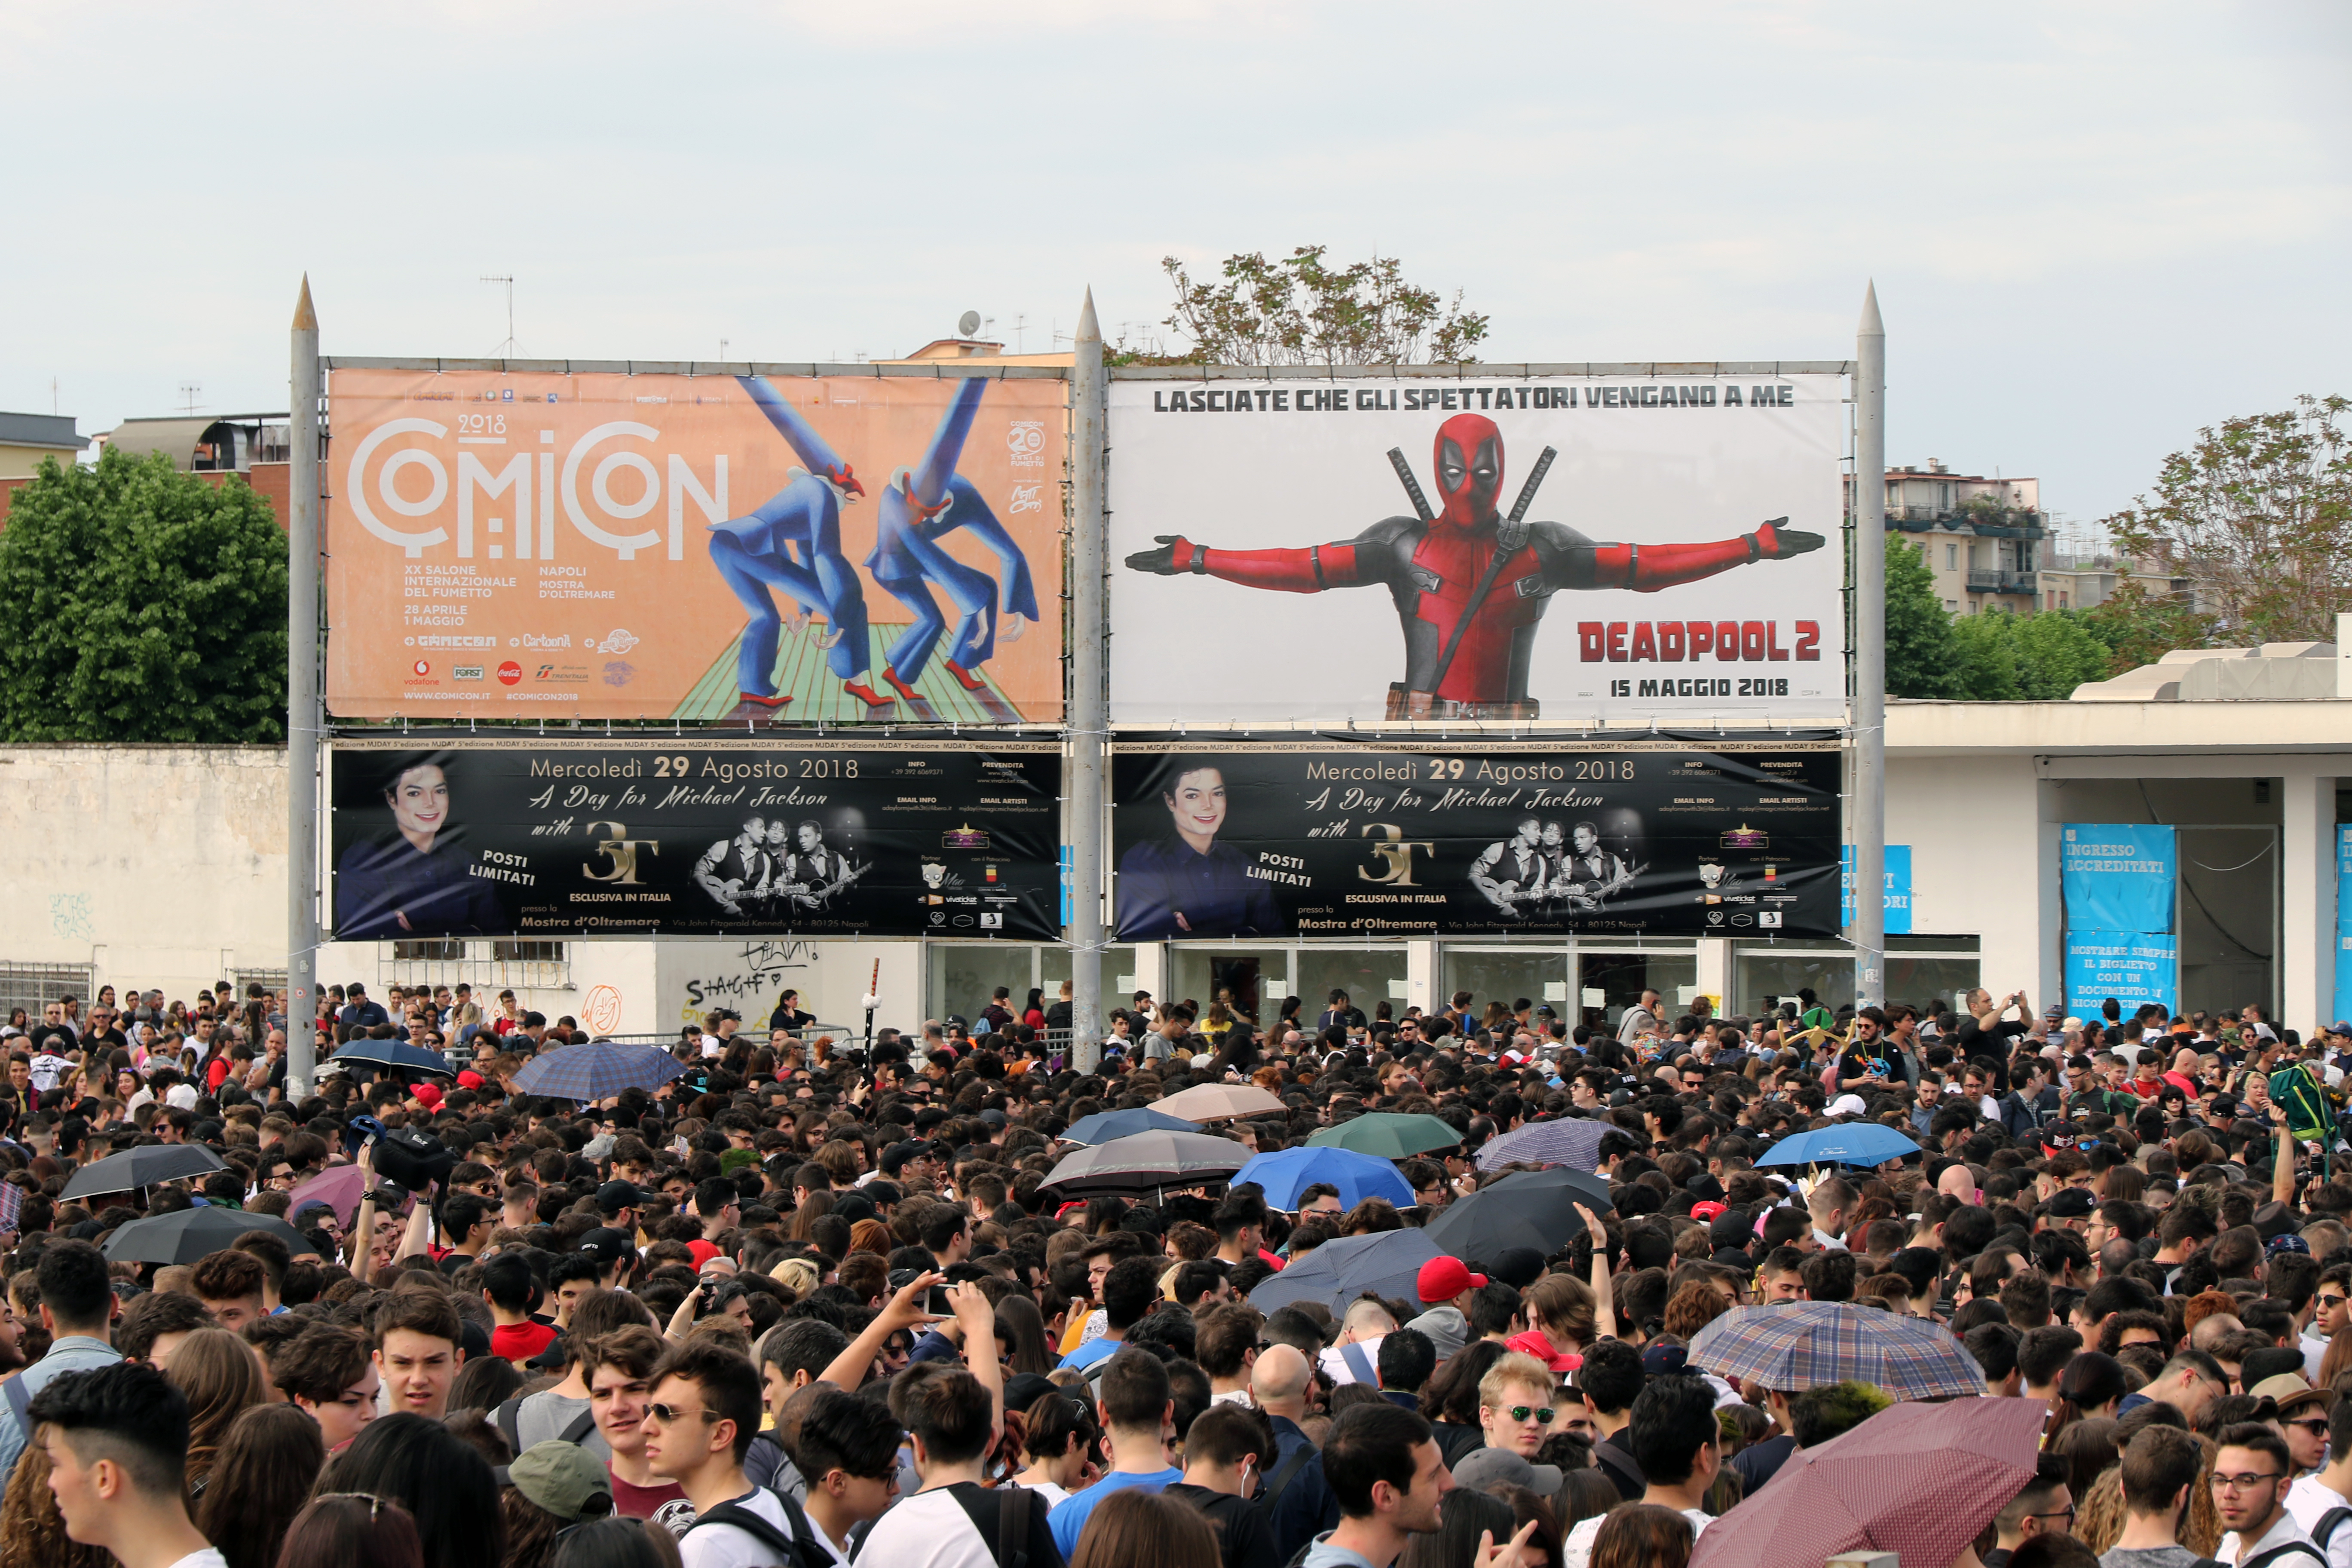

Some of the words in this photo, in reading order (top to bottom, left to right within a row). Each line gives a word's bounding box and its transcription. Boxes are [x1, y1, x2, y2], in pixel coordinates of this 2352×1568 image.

[1154, 390, 1289, 412] LASCIATE
[1295, 389, 1349, 411] CHE
[1356, 389, 1397, 411] GLI
[1404, 386, 1577, 411] SPETTATORI
[1584, 385, 1716, 408] VENGANO
[1724, 386, 1744, 407] A
[1751, 385, 1794, 407] ME
[458, 414, 506, 434] 2018
[405, 566, 422, 575] XX
[426, 566, 476, 576] SALONE
[539, 567, 586, 576] NAPOLI
[405, 577, 517, 587] INTERNAZIONALE
[539, 580, 585, 589] MOSTRA
[405, 588, 429, 597] DEL
[432, 588, 492, 598] FUMETTO
[404, 605, 419, 615] 28
[423, 605, 468, 615] APRILE
[404, 616, 409, 625] 1
[413, 616, 464, 626] MAGGIO
[1577, 620, 1790, 663] DEADPOOL
[1795, 620, 1821, 661] 2
[455, 669, 482, 677] FORST
[1611, 679, 1631, 697] 15
[1638, 678, 1731, 697] MAGGIO
[1738, 678, 1788, 696] 2018
[404, 692, 491, 701] WWW.COMICON.IT
[506, 693, 579, 701] #COMICON2018
[530, 758, 642, 778] Mercoledì
[653, 756, 690, 778] 29
[701, 756, 788, 783] Agosto
[799, 759, 859, 778] 2018
[1306, 760, 1418, 780] Mercoledì
[1428, 759, 1465, 780] 29
[1476, 758, 1564, 785] Agosto
[1575, 760, 1635, 781] 2018
[529, 784, 553, 808] A
[564, 784, 611, 811] Day
[614, 785, 647, 811] for
[655, 784, 746, 810] Michael
[750, 785, 828, 808] Jackson
[1305, 787, 1329, 811] A
[1339, 787, 1387, 813] Day
[1390, 787, 1422, 813] for
[1429, 787, 1520, 812] Michael
[1525, 787, 1604, 810] Jackson
[531, 817, 572, 838] with
[1308, 819, 1349, 839] with
[2066, 844, 2135, 857] INGRESSO
[483, 849, 528, 868] POSTI
[1259, 851, 1304, 870] POSTI
[2067, 860, 2164, 873] ACCREDITATI
[469, 864, 536, 887] LIMITATI
[1246, 865, 1312, 888] LIMITATI
[570, 893, 623, 903] ESCLUSIVA
[625, 893, 637, 902] IN
[640, 893, 671, 902] ITALIA
[1345, 894, 1399, 903] ESCLUSIVA
[1400, 894, 1413, 903] IN
[1415, 894, 1447, 903] ITALIA
[521, 906, 548, 914] presso
[549, 904, 557, 913] la
[1298, 907, 1324, 916] presso
[1326, 906, 1334, 914] la
[521, 916, 570, 927] Mostra
[689, 919, 708, 928] John
[710, 919, 750, 929] Fitzgerald
[842, 920, 870, 929] Napoli
[1298, 919, 1347, 929] Mostra
[1465, 921, 1484, 929] John
[1619, 920, 1647, 930] Napoli
[2070, 946, 2128, 956] MOSTRARE
[2132, 947, 2176, 959] SEMPRE
[2084, 959, 2096, 968] IL
[2099, 959, 2157, 971] BIGLIETTO
[2097, 973, 2122, 982] CON
[2126, 973, 2141, 983] UN
[2077, 985, 2148, 996] DOCUMENTO
